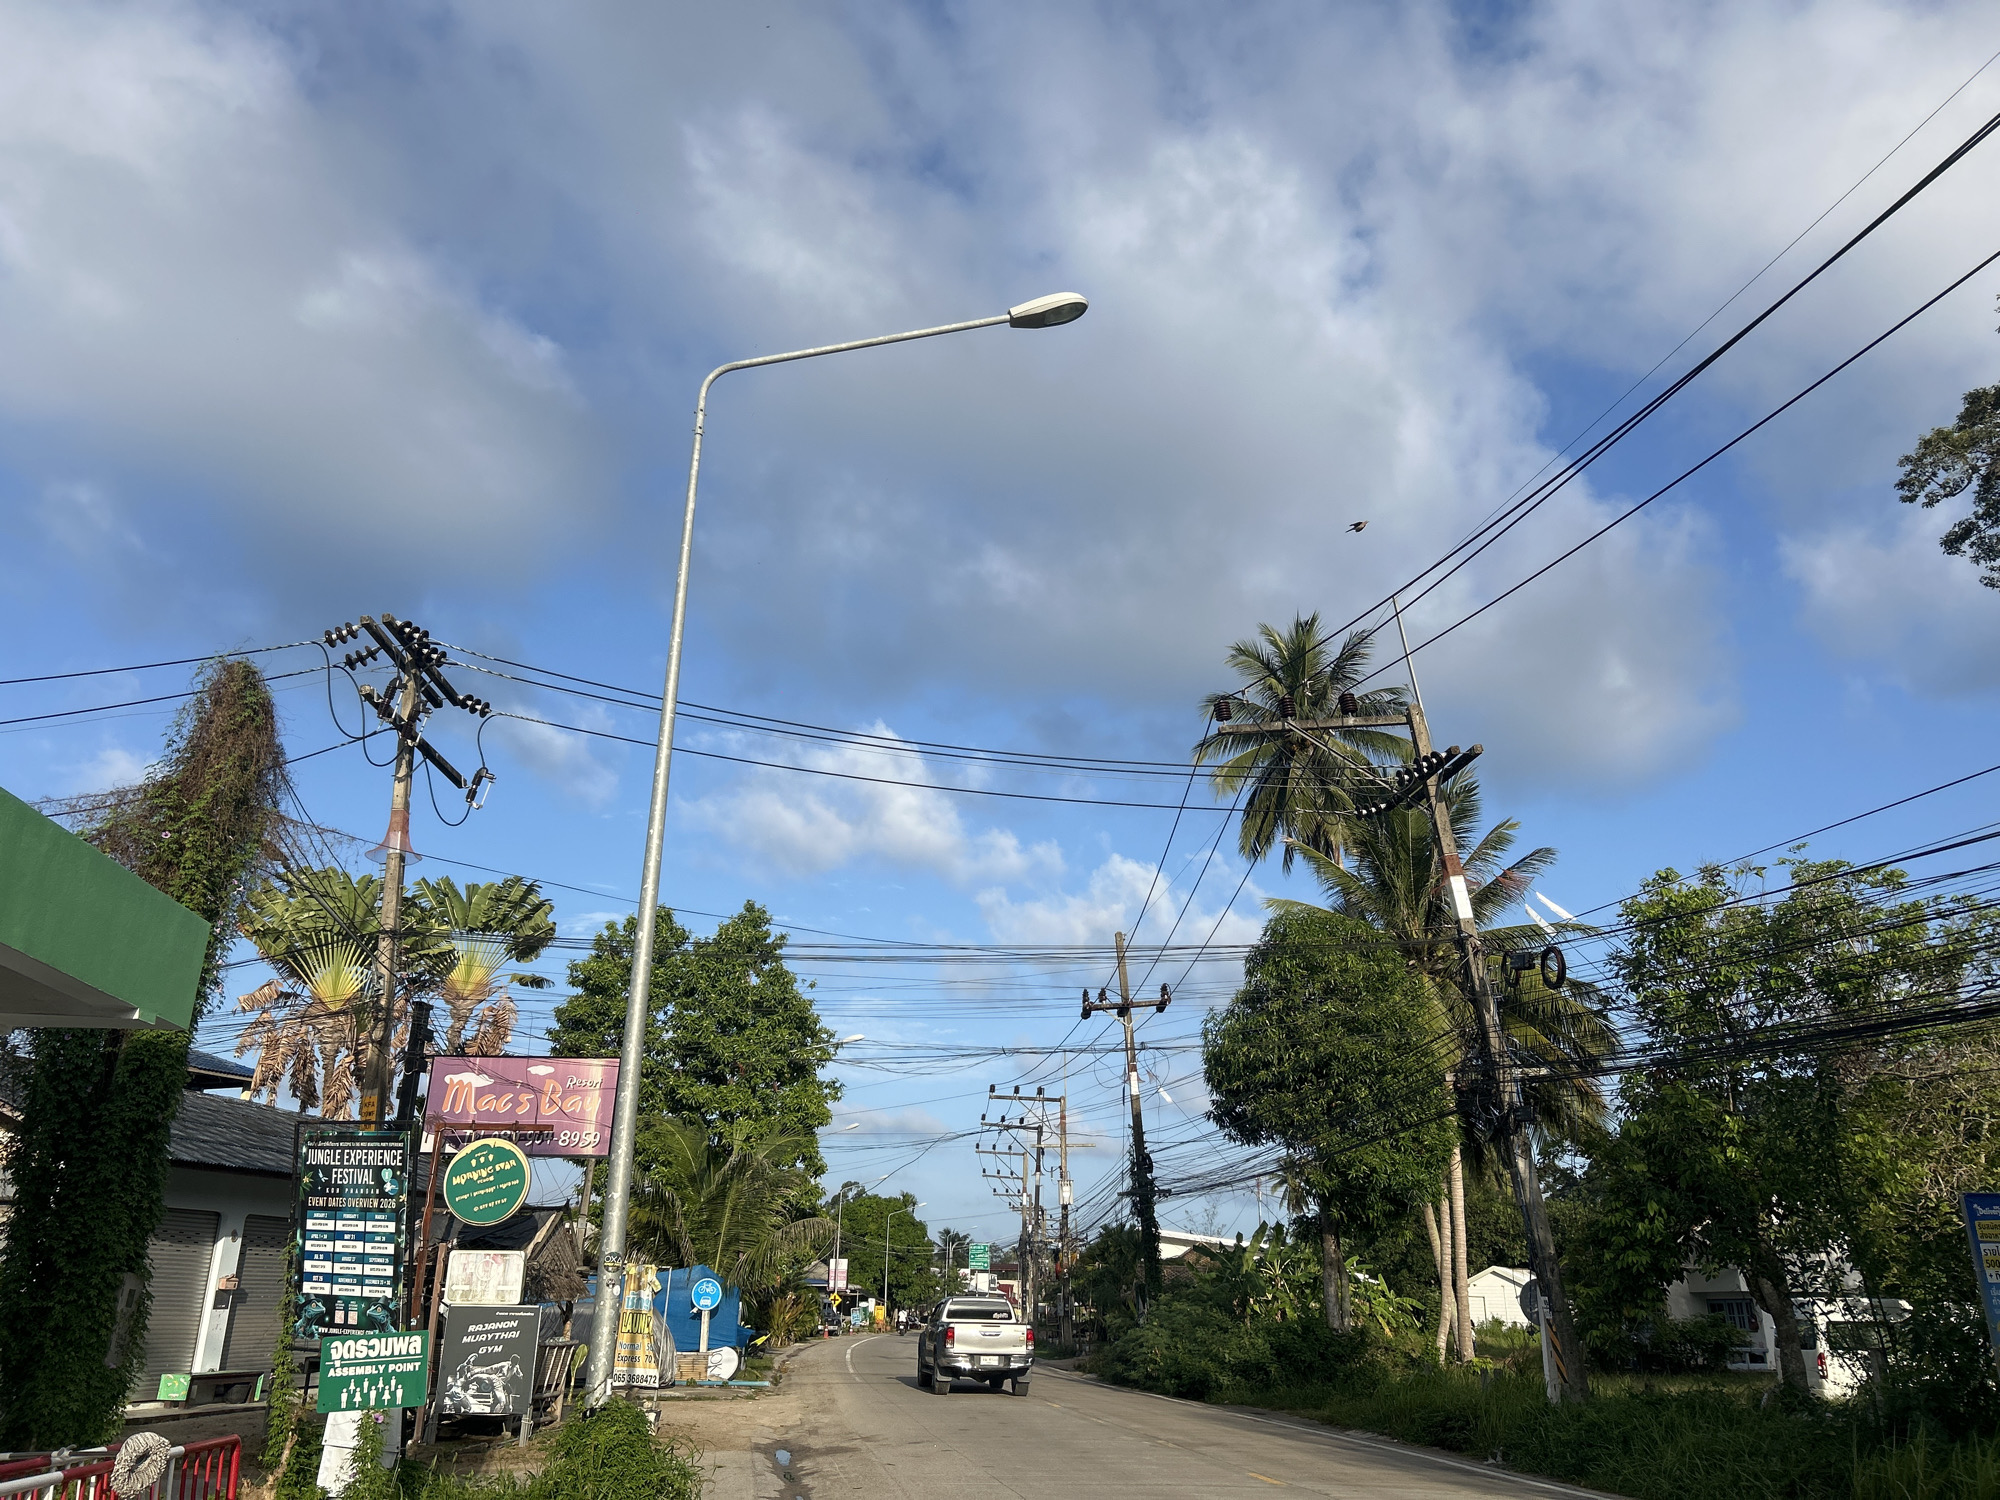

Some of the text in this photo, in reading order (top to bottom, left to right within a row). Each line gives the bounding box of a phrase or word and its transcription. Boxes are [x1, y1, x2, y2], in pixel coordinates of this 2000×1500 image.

[565, 1075, 603, 1090] Resort
[540, 1078, 602, 1121] Bay
[306, 1149, 403, 1166] JUNGLE EXPERIENCE
[331, 1168, 375, 1185] FESTIVAL
[308, 1196, 396, 1209] EVENT DATES OVERVIEW 2026
[467, 1320, 519, 1333] RAJANON
[462, 1330, 520, 1344] MUAYTHAI
[330, 1335, 422, 1367] จุดรวมพล
[478, 1345, 503, 1354] GYM
[618, 1341, 642, 1351] Normal
[617, 1352, 641, 1364] Express
[327, 1362, 422, 1378] ASSEMBLY POINT
[613, 1373, 657, 1385] 065 3688472
